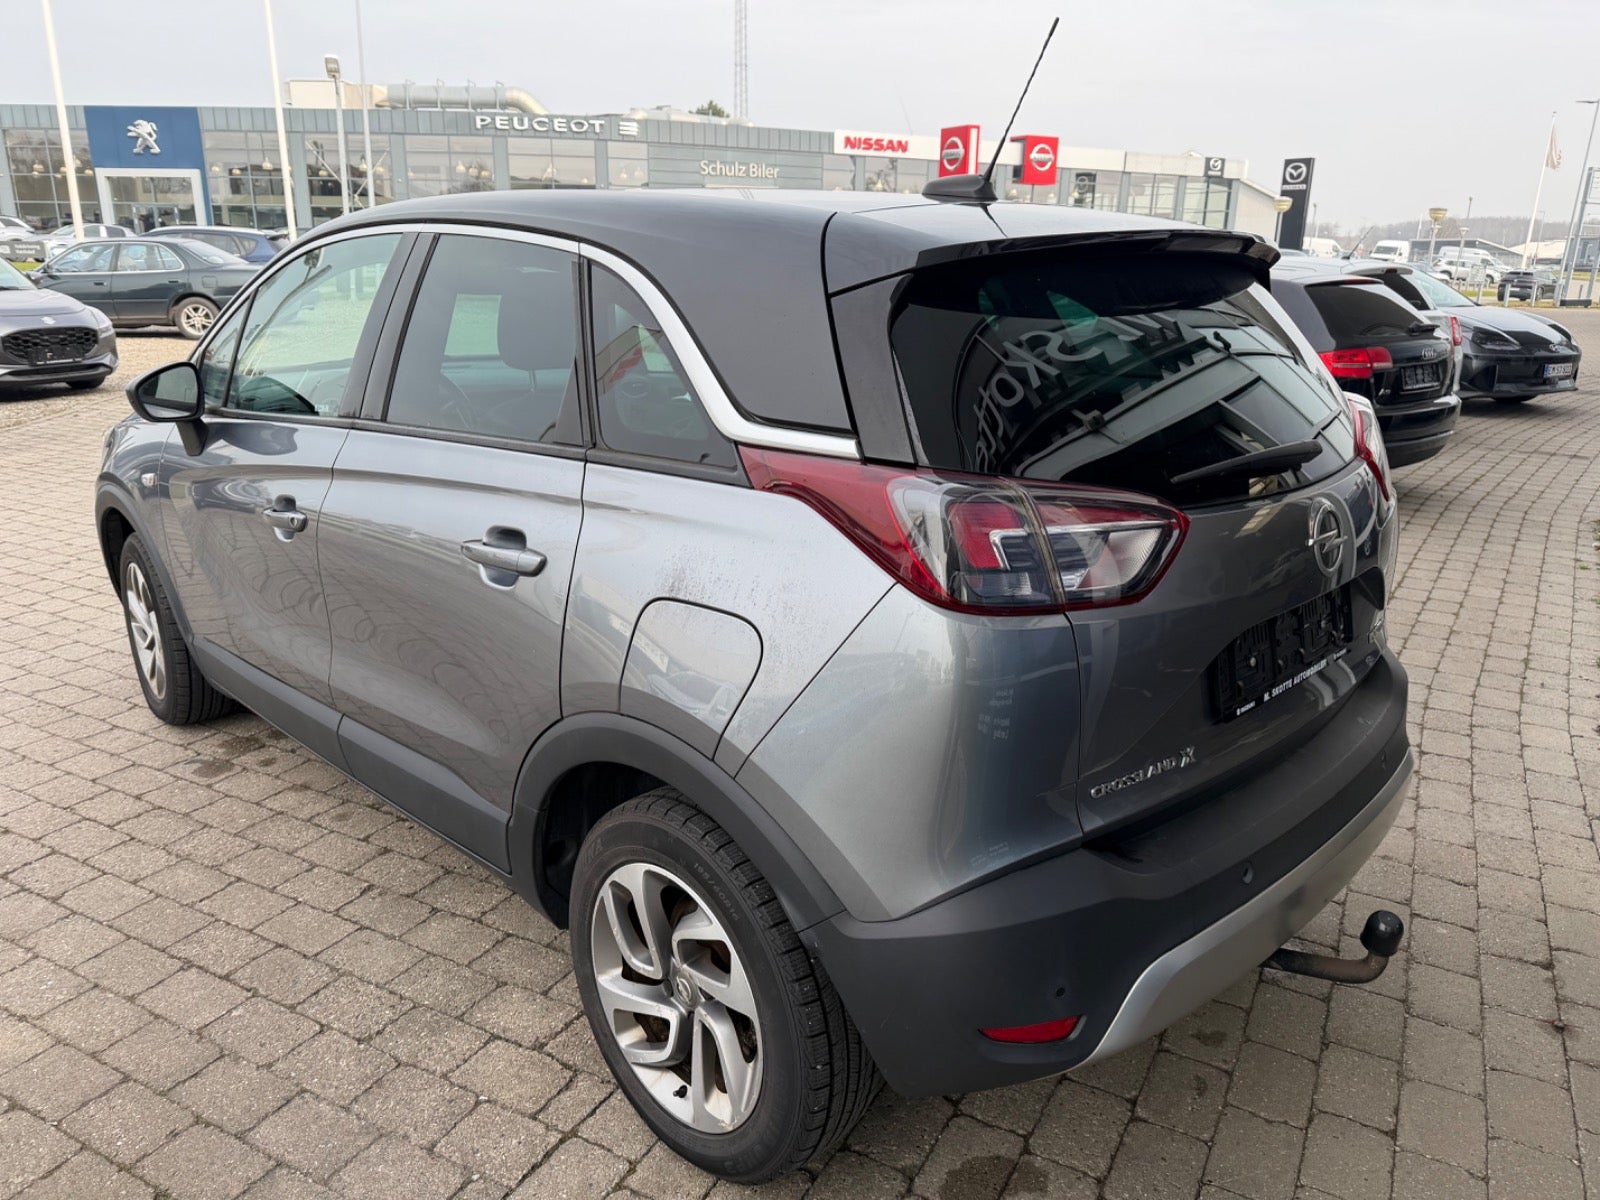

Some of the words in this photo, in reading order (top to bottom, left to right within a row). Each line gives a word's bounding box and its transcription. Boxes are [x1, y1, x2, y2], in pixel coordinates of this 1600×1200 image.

[475, 115, 605, 134] PEUGEOT
[844, 135, 909, 153] NISSAN
[700, 159, 747, 177] Schulz
[749, 161, 780, 179] Biler
[1090, 757, 1176, 799] CROSSLAND
